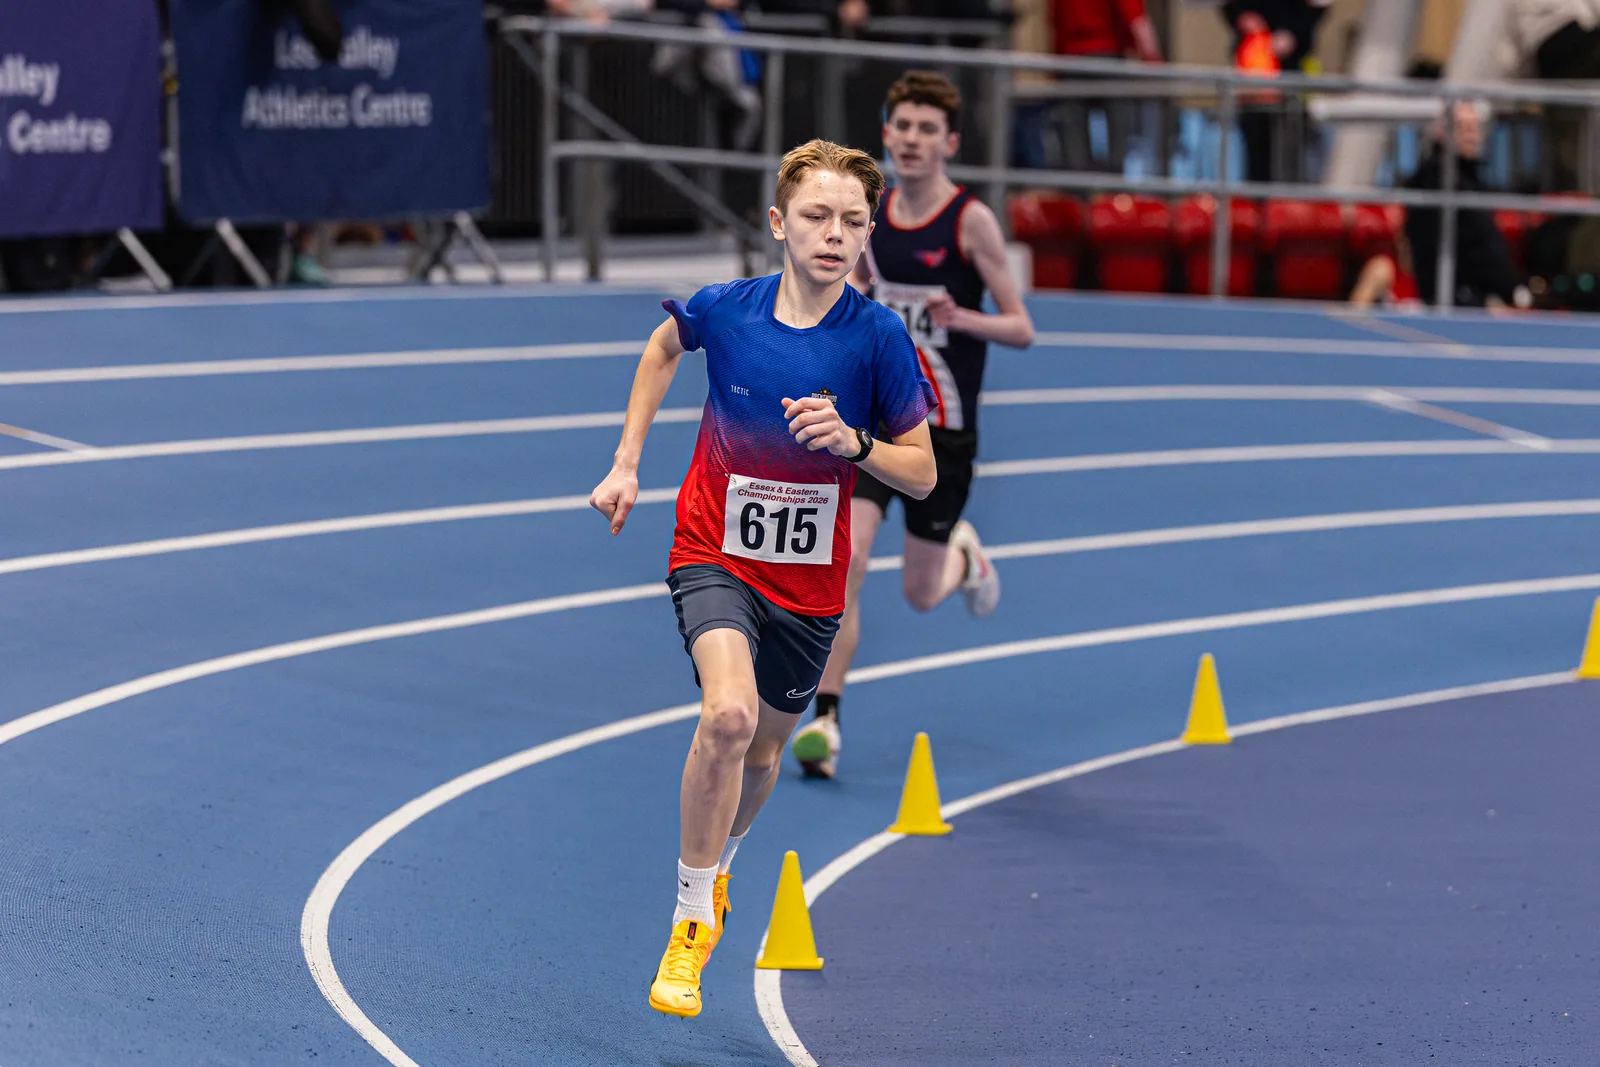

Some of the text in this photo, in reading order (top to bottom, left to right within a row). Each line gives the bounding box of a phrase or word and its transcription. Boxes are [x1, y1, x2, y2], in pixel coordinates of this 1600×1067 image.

[338, 26, 399, 79] alley
[242, 83, 432, 129] Athletics Centre
[7, 110, 111, 154] Centre
[887, 302, 932, 340] 14
[737, 489, 829, 505] Championships 2026
[749, 482, 775, 492] Essex
[785, 487, 819, 496] Eastern
[740, 502, 818, 554] 615
